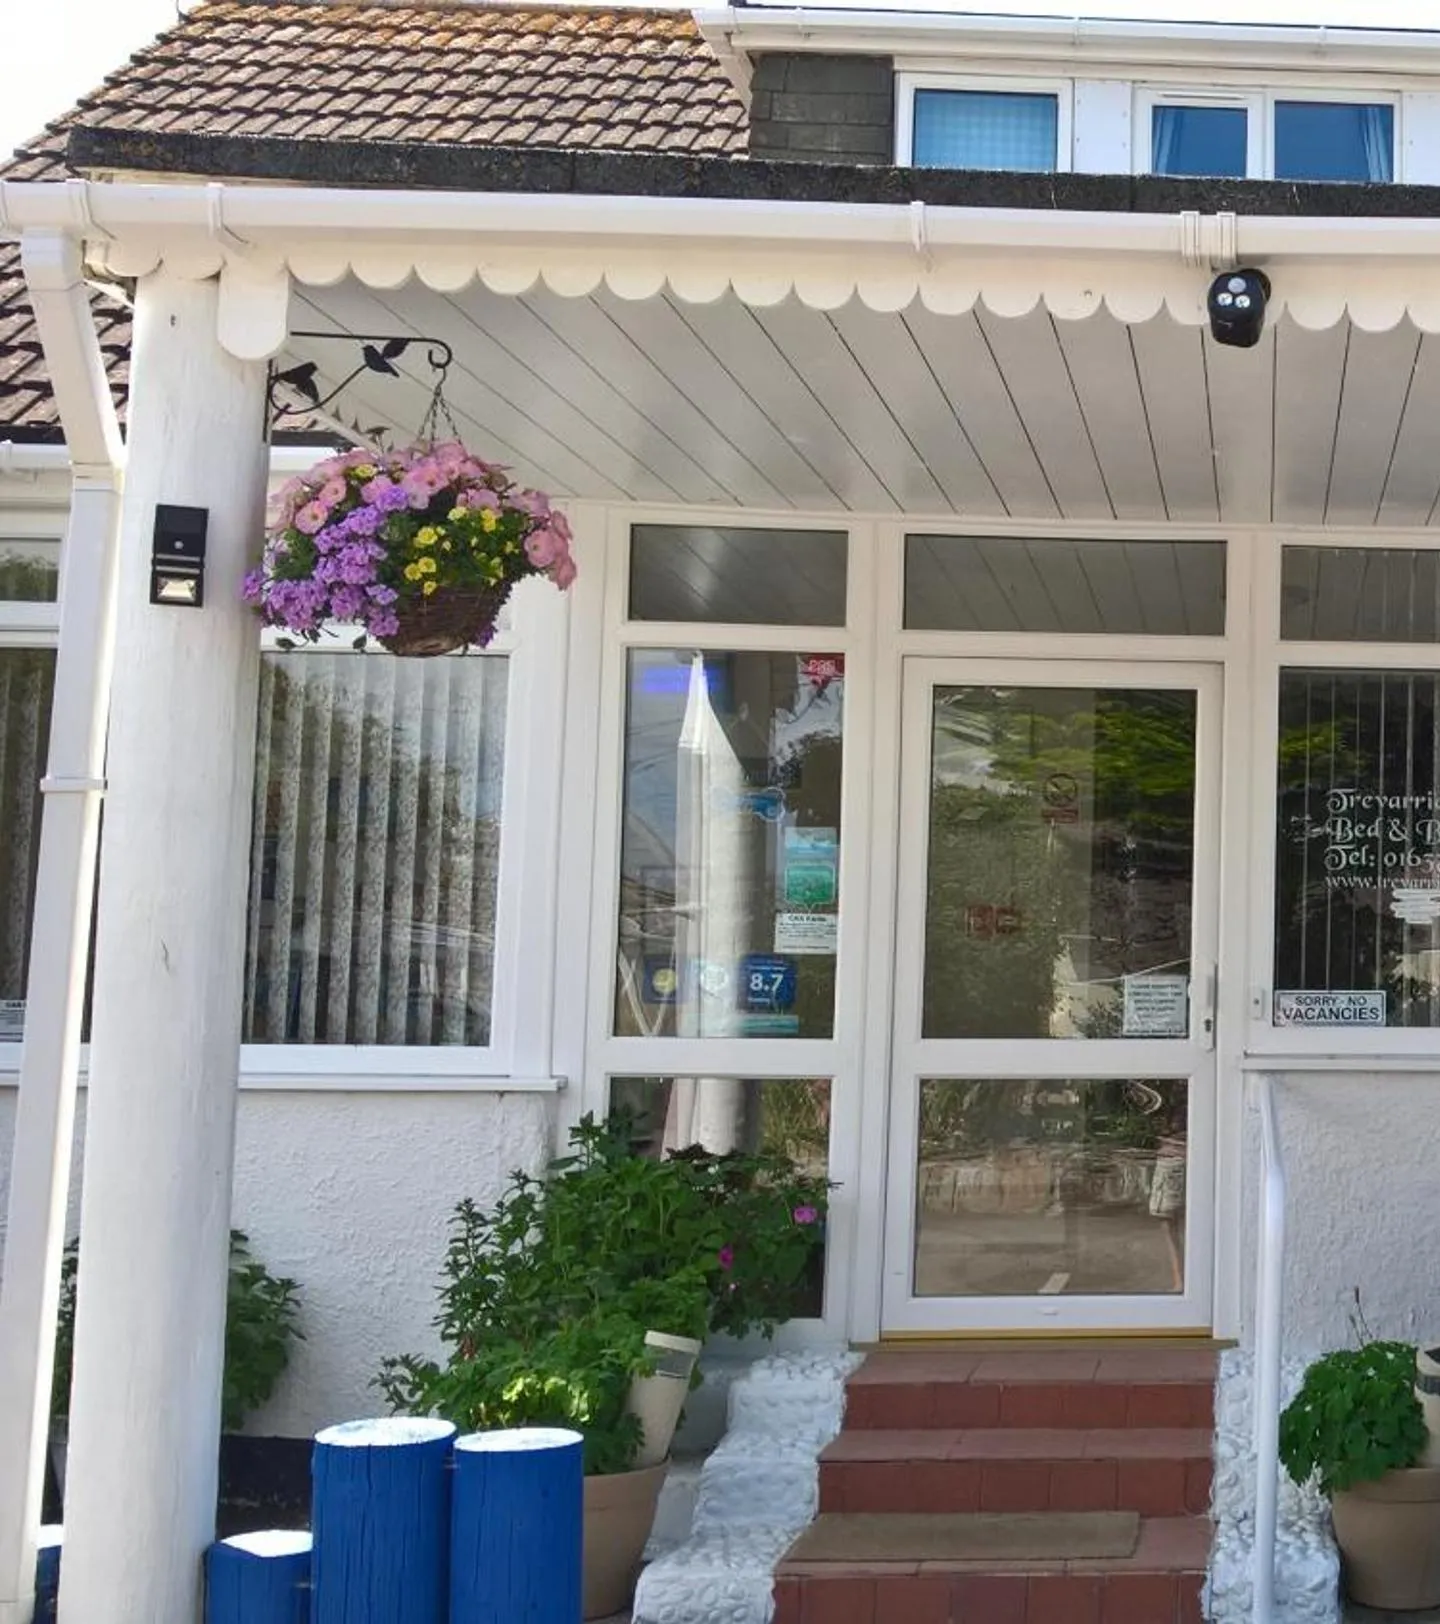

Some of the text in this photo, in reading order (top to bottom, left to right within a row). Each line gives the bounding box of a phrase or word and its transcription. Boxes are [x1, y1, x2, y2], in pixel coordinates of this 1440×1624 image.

[1325, 817, 1383, 843] Bed
[1389, 818, 1410, 841] &
[1324, 844, 1375, 870] Tel:
[749, 973, 783, 992] 8.7
[1295, 995, 1338, 1007] SORRY
[1282, 1007, 1380, 1021] VACANCIES
